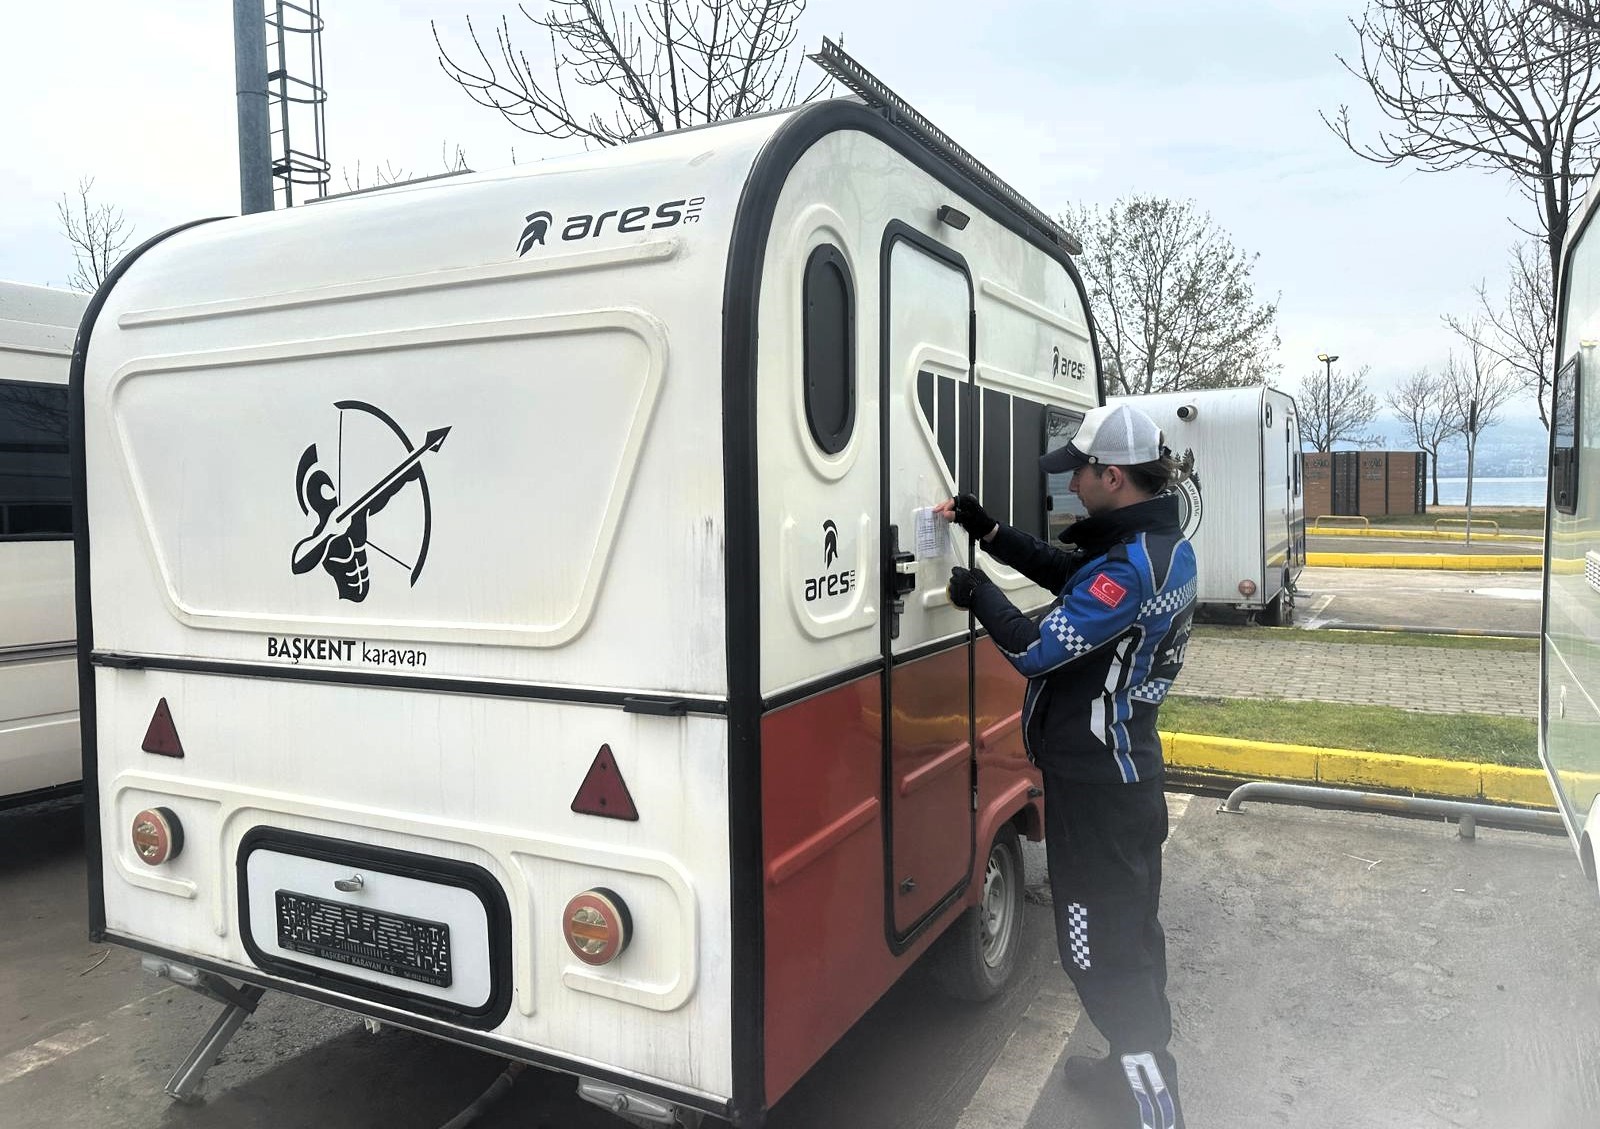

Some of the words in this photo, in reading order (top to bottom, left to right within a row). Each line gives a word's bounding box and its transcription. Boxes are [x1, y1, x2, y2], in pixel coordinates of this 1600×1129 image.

[562, 200, 686, 241] ares
[683, 197, 705, 224] 310
[1061, 357, 1083, 380] ares
[1185, 480, 1200, 517] EXPLORING
[805, 570, 849, 601] ares
[267, 637, 356, 664] BAŞKENT
[362, 641, 427, 667] karavan
[351, 955, 382, 971] KARAVAN
